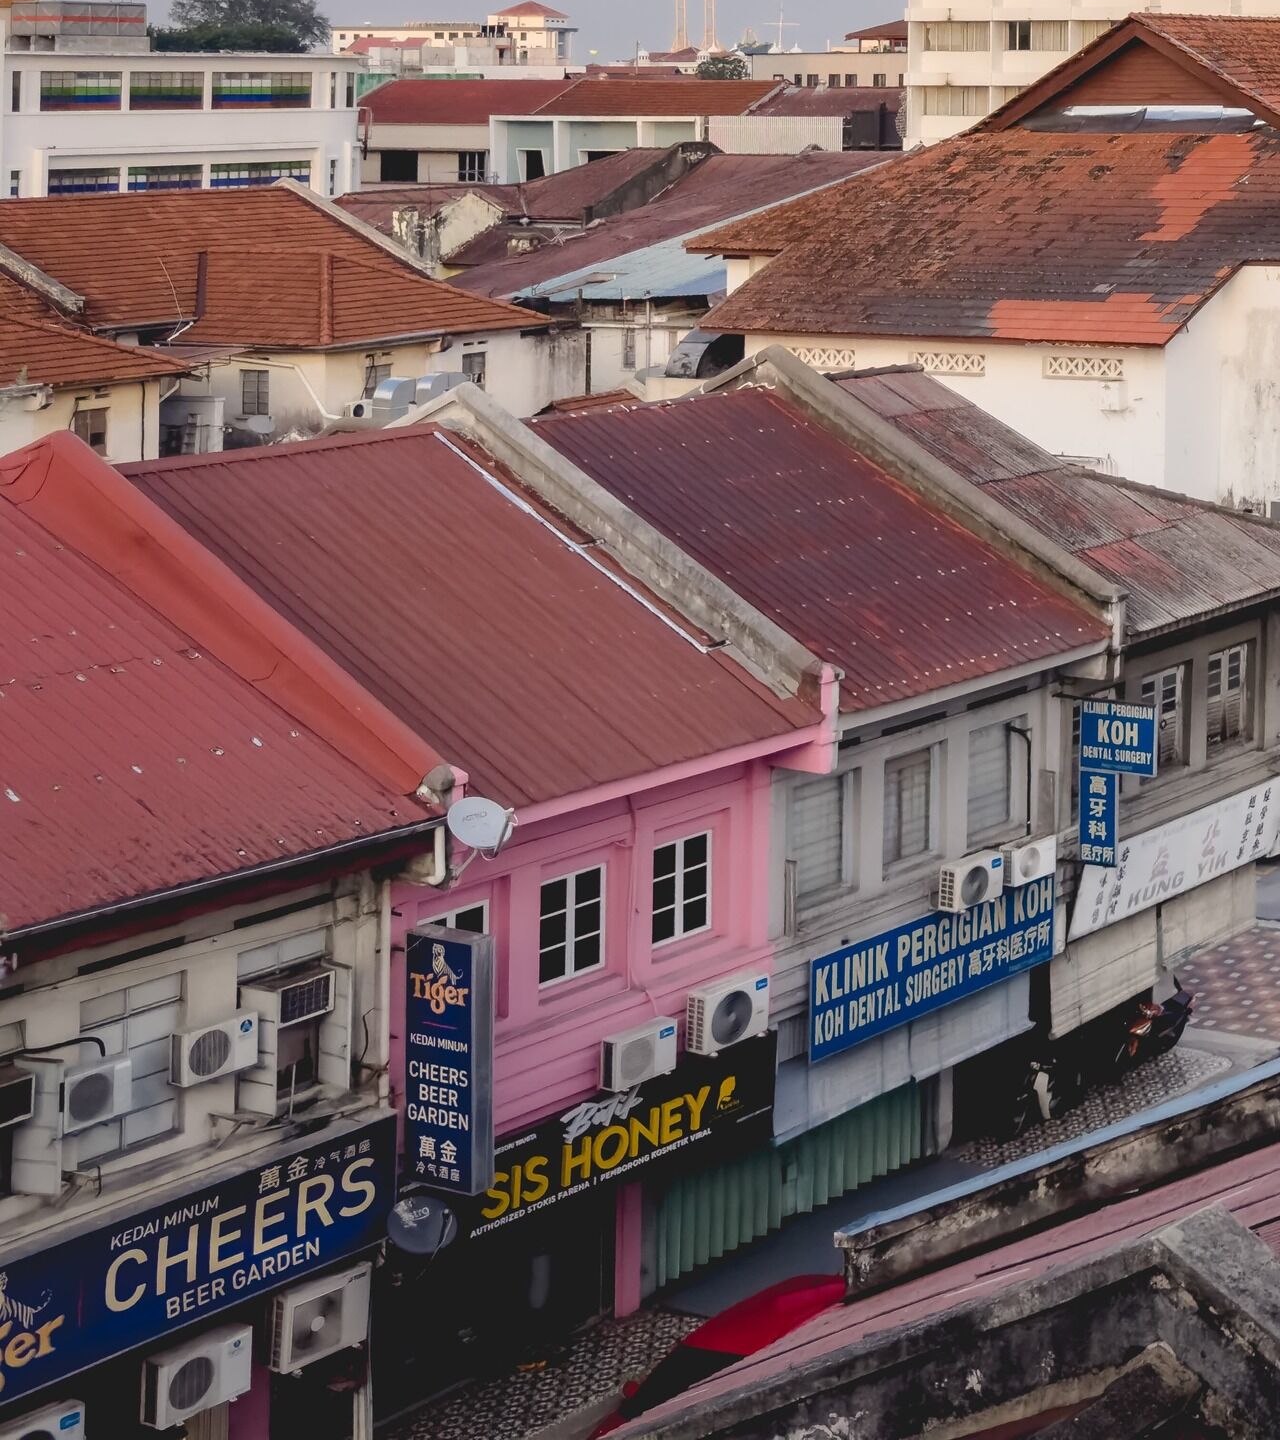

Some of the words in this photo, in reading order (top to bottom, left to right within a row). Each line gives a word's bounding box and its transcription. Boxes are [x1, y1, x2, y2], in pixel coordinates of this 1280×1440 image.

[1083, 701, 1109, 715] KLINIK
[1111, 703, 1153, 720] PERGIGIAN
[1097, 718, 1139, 747] KOH
[1083, 745, 1112, 761] DENTAL
[1115, 748, 1152, 765] SURGERY
[1088, 775, 1107, 841] 高牙科
[1081, 843, 1114, 864] 医疗所
[1128, 871, 1185, 909] KUNG
[1197, 850, 1229, 878] YIK
[815, 941, 890, 1007] KLINIK
[897, 898, 1007, 973] PERGIGIAN
[1013, 877, 1054, 925] KOH
[968, 918, 1051, 979] 高牙科医疗所
[410, 971, 469, 1015] Tiger
[814, 1005, 844, 1046] KOH
[848, 982, 901, 1032] DENTAL
[905, 954, 965, 1007] SURGERY
[410, 1032, 436, 1048] KEDAI
[437, 1035, 468, 1054] MINUM
[409, 1060, 468, 1088] CHEERS
[418, 1083, 458, 1107] BEER
[408, 1103, 469, 1131] GARDEN
[418, 1135, 457, 1164] 萬金
[481, 1155, 549, 1220] SIS
[561, 1085, 711, 1188] HONEY
[258, 1156, 309, 1194] 萬金
[470, 1208, 526, 1239] AUTHORIZED
[526, 1194, 556, 1214] STOKIS
[600, 1153, 650, 1183] PEMBORONG
[651, 1137, 689, 1160] KOSMETIK
[690, 1127, 712, 1143] VIRAL
[105, 1157, 375, 1312] CHEERS
[110, 1219, 159, 1251] KEDAI
[164, 1195, 220, 1230] MINUM
[166, 1278, 226, 1319] BEER
[232, 1237, 320, 1290] GARDEN
